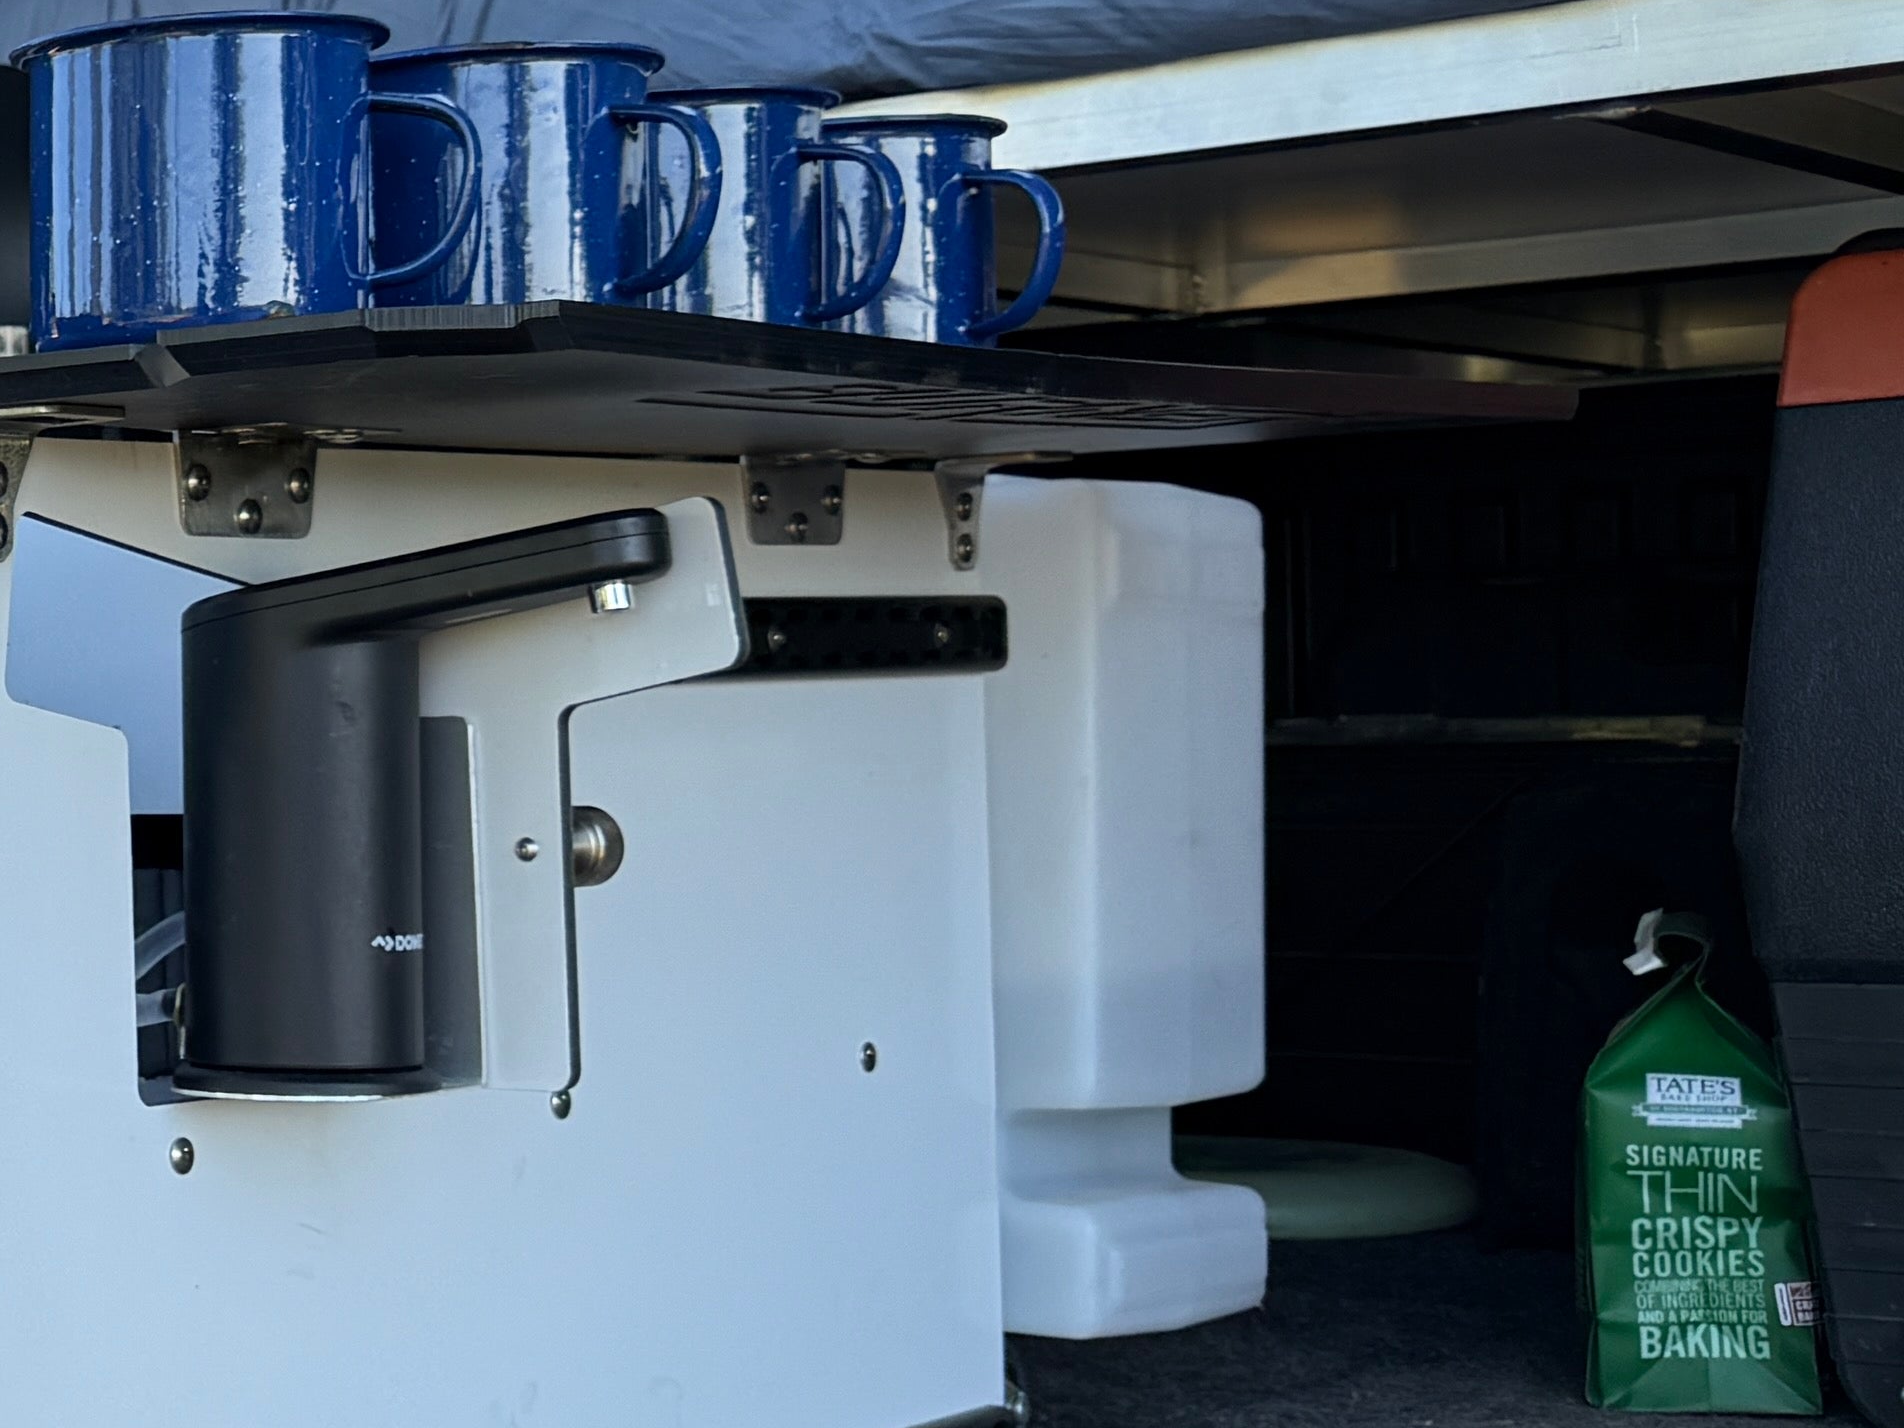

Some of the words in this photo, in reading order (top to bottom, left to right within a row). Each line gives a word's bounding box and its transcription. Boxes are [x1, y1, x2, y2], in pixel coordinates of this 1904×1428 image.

[1650, 1076, 1736, 1096] TATE'S
[1626, 1144, 1763, 1170] SIGNATURE
[1626, 1170, 1758, 1213] THIN
[1632, 1215, 1763, 1250] CRISPY
[1632, 1249, 1765, 1278] COOKIES
[1733, 1278, 1765, 1292] BEST
[1636, 1293, 1656, 1309] OF
[1662, 1292, 1766, 1309] INGREDIENTS
[1638, 1310, 1665, 1324] AND
[1668, 1310, 1678, 1324] A
[1741, 1310, 1768, 1324] FOR
[1640, 1323, 1771, 1360] BAKING
